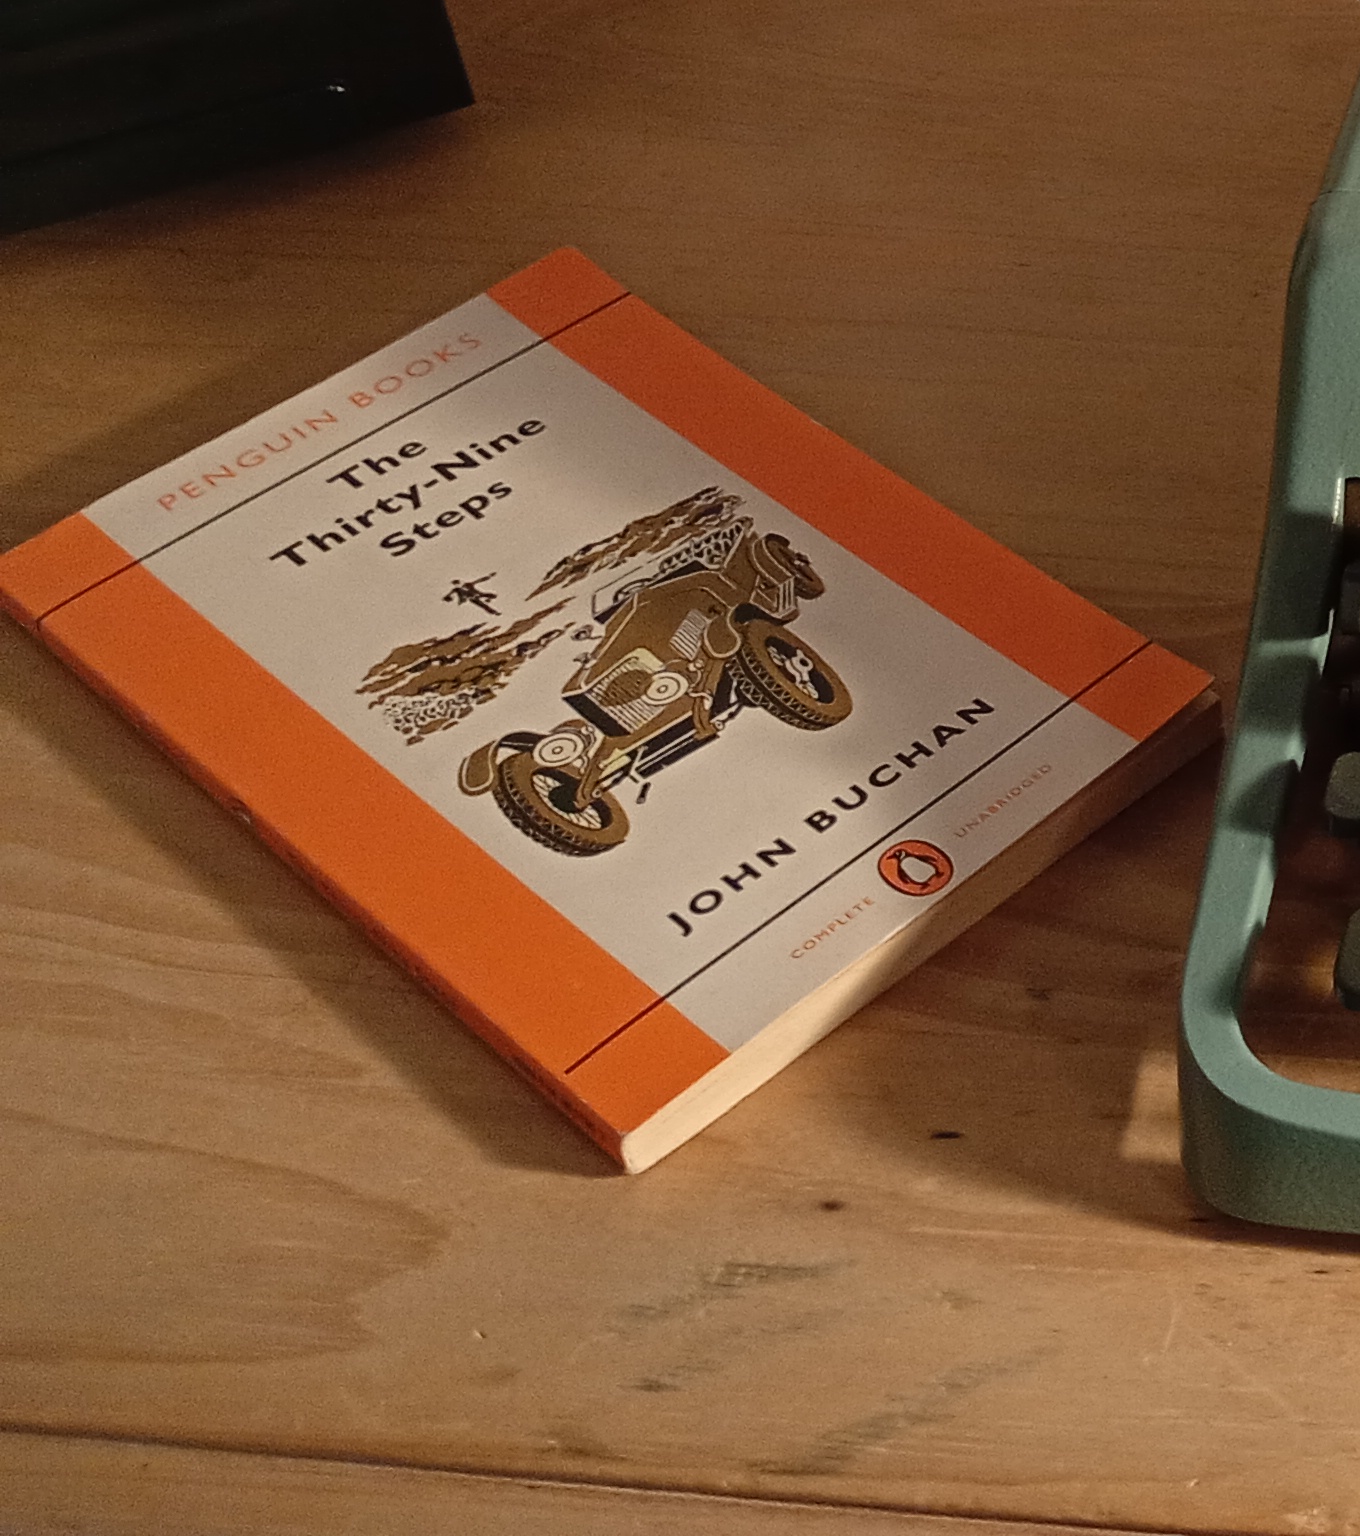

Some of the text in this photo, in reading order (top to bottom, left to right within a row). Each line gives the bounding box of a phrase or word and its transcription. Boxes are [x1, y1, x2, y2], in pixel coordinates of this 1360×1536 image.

[157, 332, 483, 511] PENGUIN BOOKS
[269, 418, 546, 568] Thirty-Nine
[326, 439, 429, 490] The
[379, 480, 513, 558] Steps
[666, 697, 995, 937] JOHN BUCHAN
[953, 763, 1053, 840] UNABRIDGED
[789, 895, 875, 960] COMPLETE
